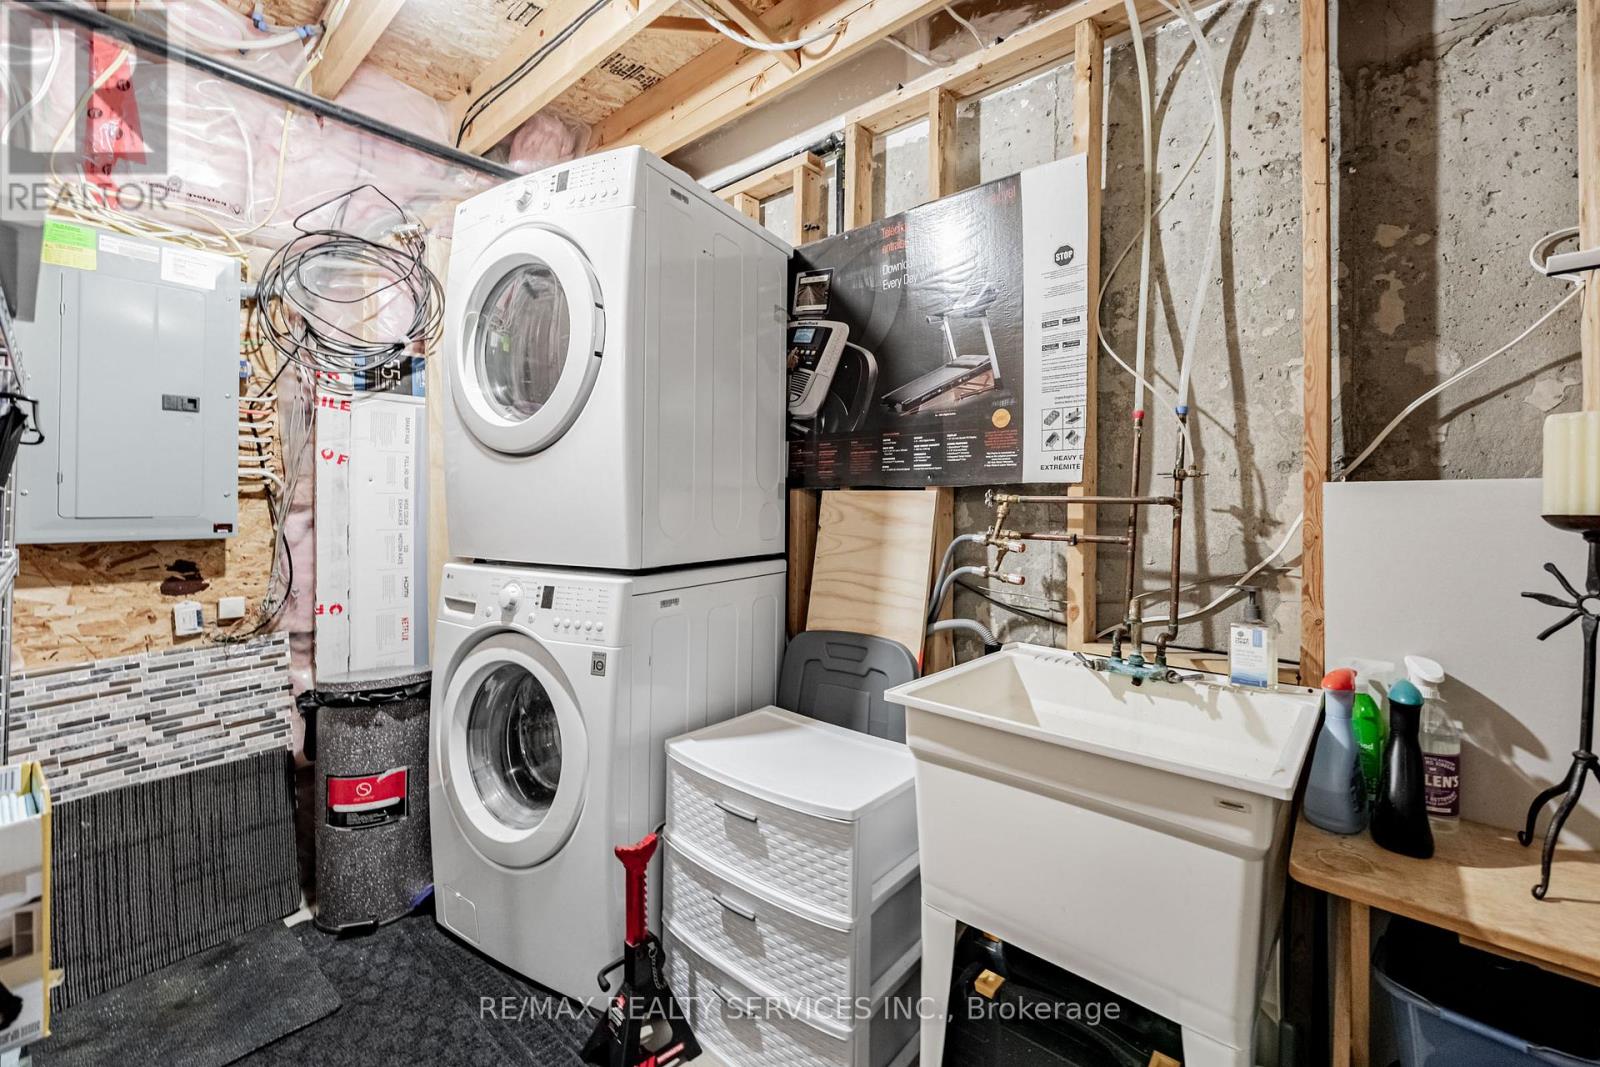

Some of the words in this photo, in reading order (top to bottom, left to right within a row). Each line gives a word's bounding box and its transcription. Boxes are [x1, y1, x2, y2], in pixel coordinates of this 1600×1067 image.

[1055, 249, 1074, 263] STOP
[882, 277, 903, 291] Every
[1053, 454, 1077, 462] HEAVY
[401, 617, 409, 641] NETFLIX
